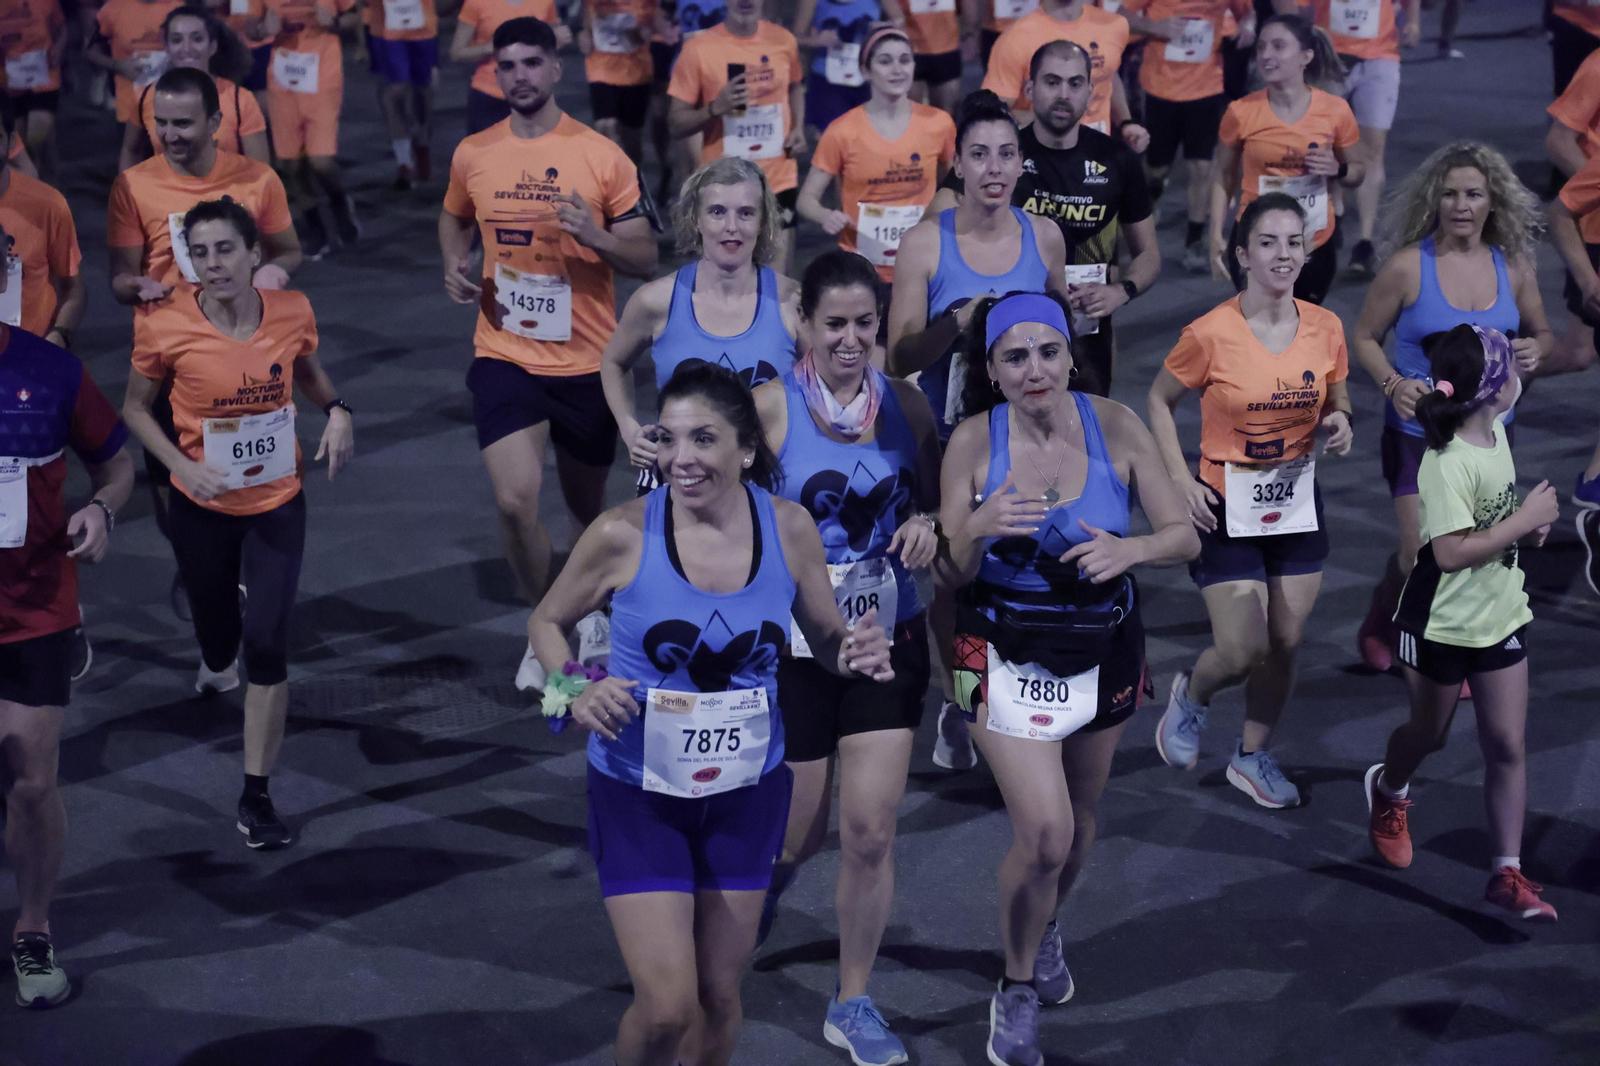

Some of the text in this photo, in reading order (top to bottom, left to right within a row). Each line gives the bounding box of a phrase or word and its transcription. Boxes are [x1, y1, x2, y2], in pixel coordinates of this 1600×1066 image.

[515, 183, 561, 193] NOCTURNA
[1022, 196, 1107, 222] ARUNCI
[509, 290, 556, 314] 14378
[1271, 390, 1320, 401] NOCTURNA
[1292, 399, 1318, 410] KH7
[232, 436, 276, 459] 6163
[1253, 481, 1294, 503] 3324
[835, 592, 879, 619] 108
[1017, 677, 1069, 704] 7880
[682, 727, 741, 754] 7875
